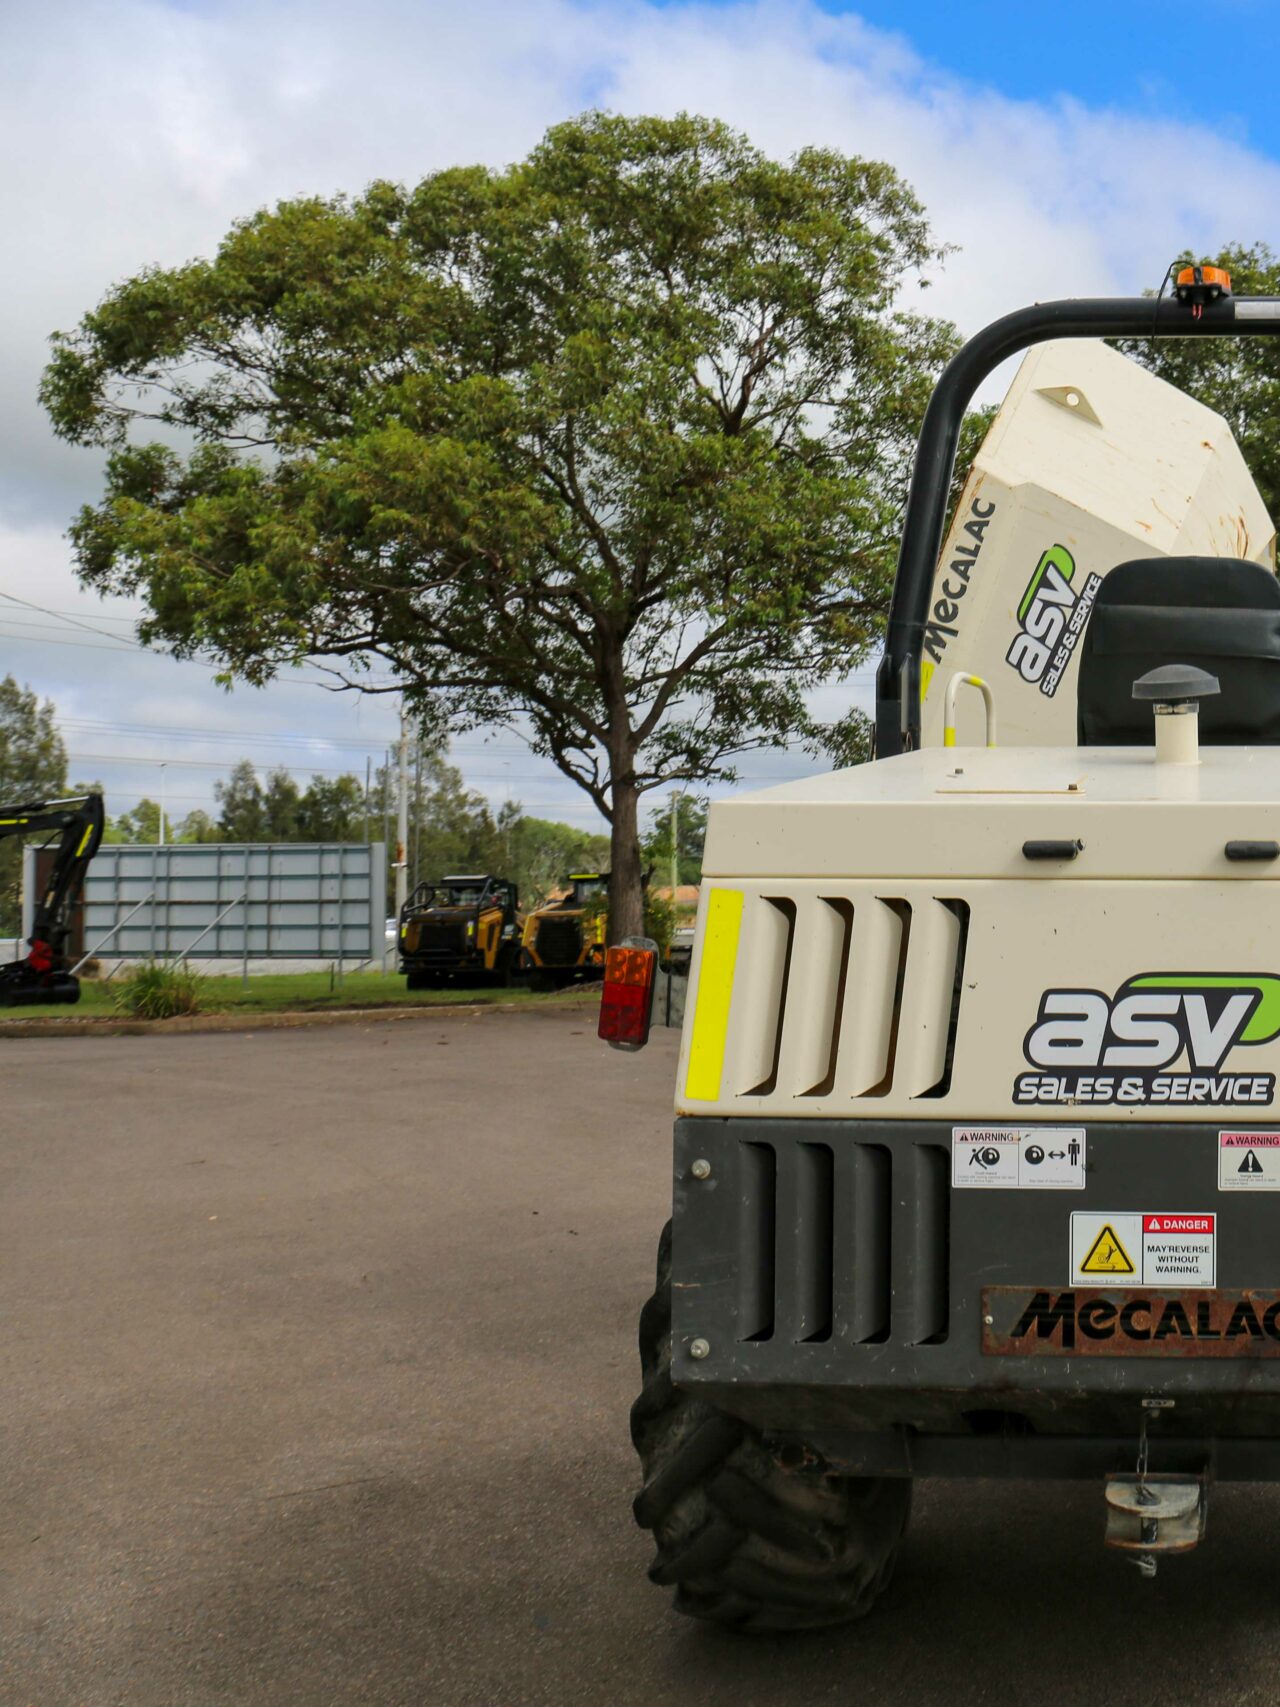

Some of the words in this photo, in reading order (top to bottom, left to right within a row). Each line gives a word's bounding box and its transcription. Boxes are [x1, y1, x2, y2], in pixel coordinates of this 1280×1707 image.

[1069, 574, 1103, 634] SERVICE
[1062, 632, 1078, 650] &
[1116, 1077, 1146, 1101] &
[1149, 1077, 1270, 1101] SERVICE
[969, 1132, 1014, 1142] WARNING
[1235, 1136, 1280, 1146] WARNING
[1163, 1219, 1209, 1230] DANGER
[1147, 1245, 1167, 1253] MAY
[1168, 1245, 1210, 1254] REVERSE
[1157, 1255, 1200, 1264] WITHOUT
